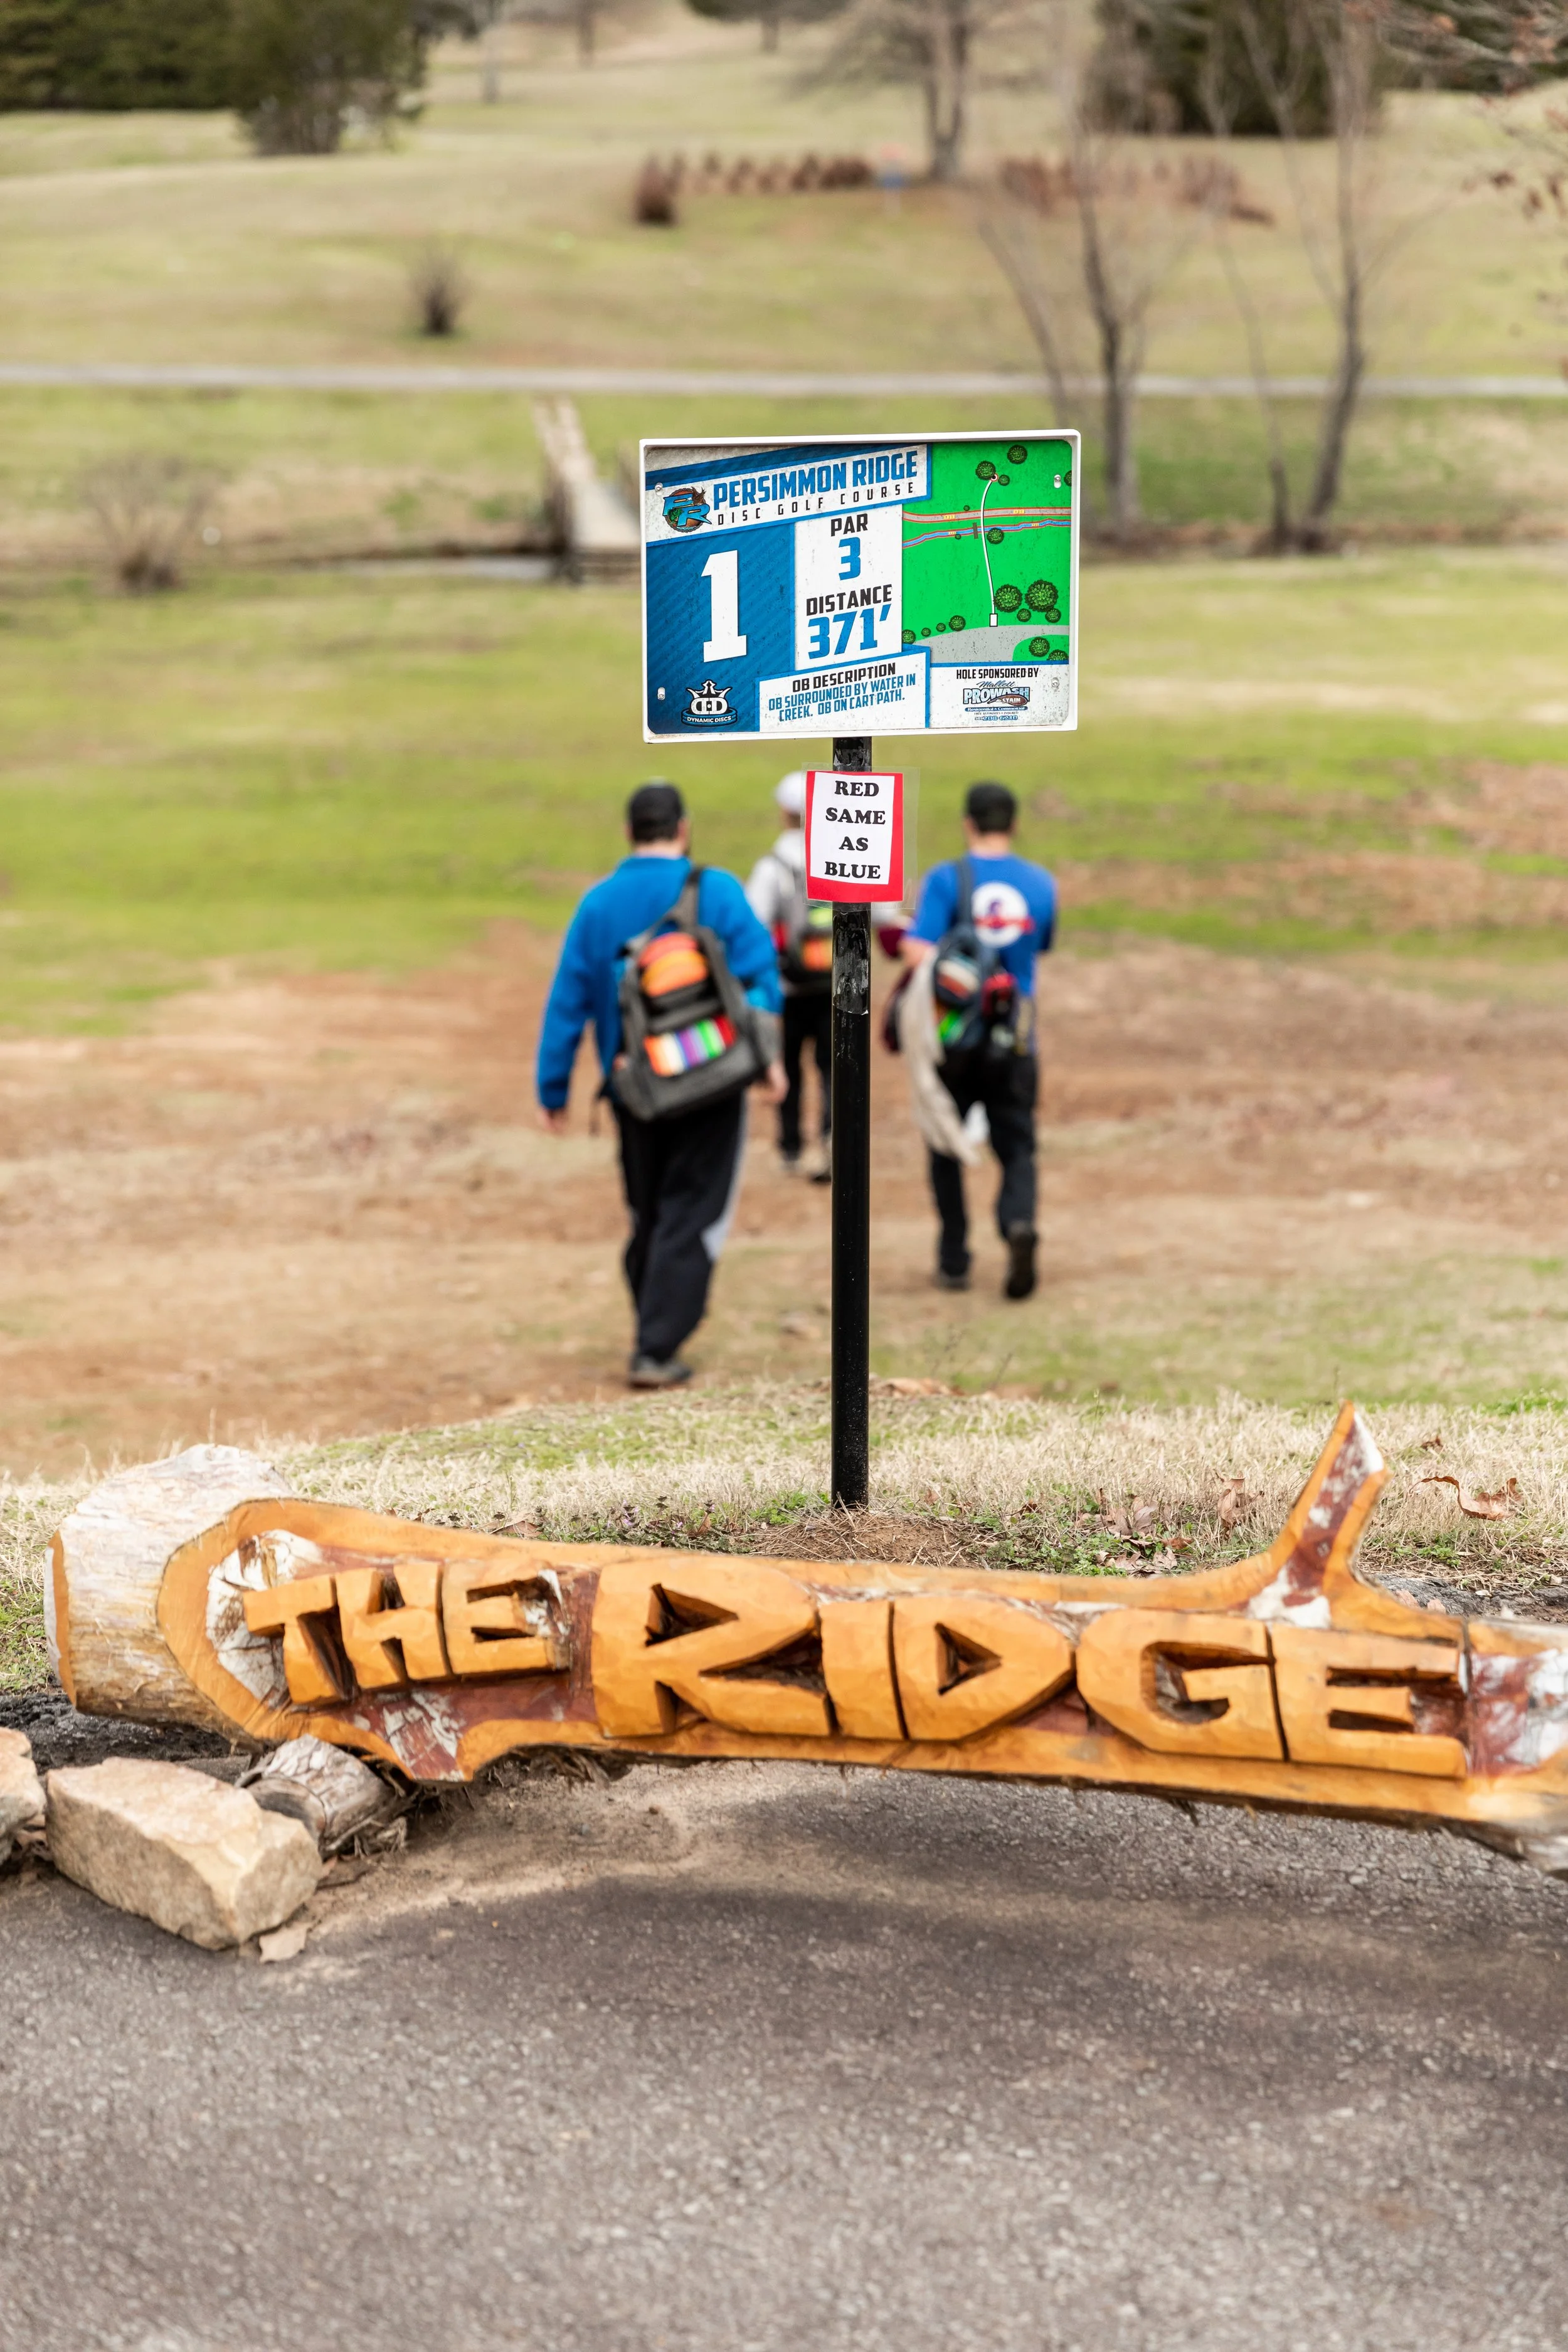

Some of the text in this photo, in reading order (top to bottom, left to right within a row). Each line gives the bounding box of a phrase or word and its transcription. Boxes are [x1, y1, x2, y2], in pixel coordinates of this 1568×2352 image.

[714, 450, 918, 511] PERSIMMON RIDGE
[718, 482, 913, 525] DISC GOLF COURSE
[831, 513, 868, 537] PAR
[839, 537, 861, 581] 3
[701, 549, 747, 663] 1
[807, 584, 892, 616] DISTANCE
[808, 603, 891, 659] 371'
[792, 662, 896, 692] OB DESCRIPTION
[956, 667, 1039, 679] HOLE SPONSORED BY
[768, 673, 916, 711] OB SURROUNDED BY WATER IN
[779, 689, 905, 721] CREEK. OB ON CART PATH.
[963, 687, 1030, 704] PROWASH
[834, 780, 879, 797] RED
[825, 807, 886, 825] SAME
[839, 836, 869, 851] AS
[824, 861, 881, 879] BLUE
[243, 1556, 1466, 1779] THE RIDGE
